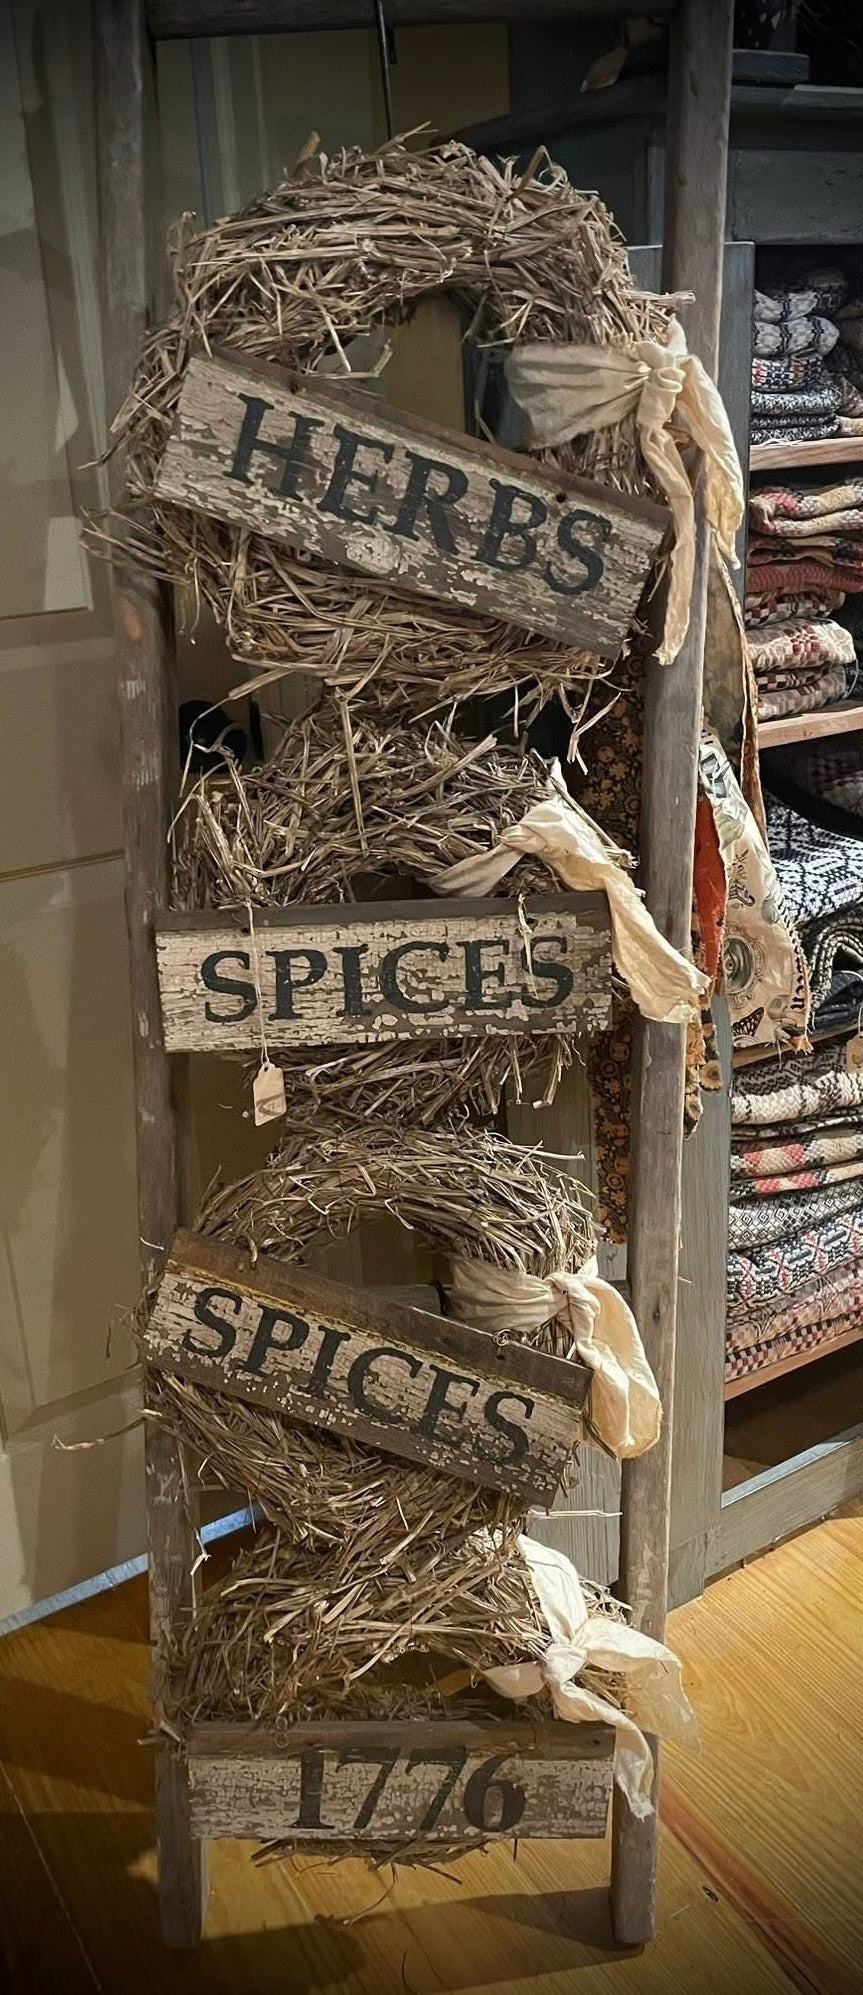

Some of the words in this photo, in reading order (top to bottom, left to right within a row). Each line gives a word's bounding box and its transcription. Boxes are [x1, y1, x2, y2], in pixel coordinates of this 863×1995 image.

[224, 393, 612, 595] HERBS
[201, 936, 575, 1023] SPICES
[182, 1286, 535, 1465] SPICES
[291, 1746, 526, 1833] 1776
